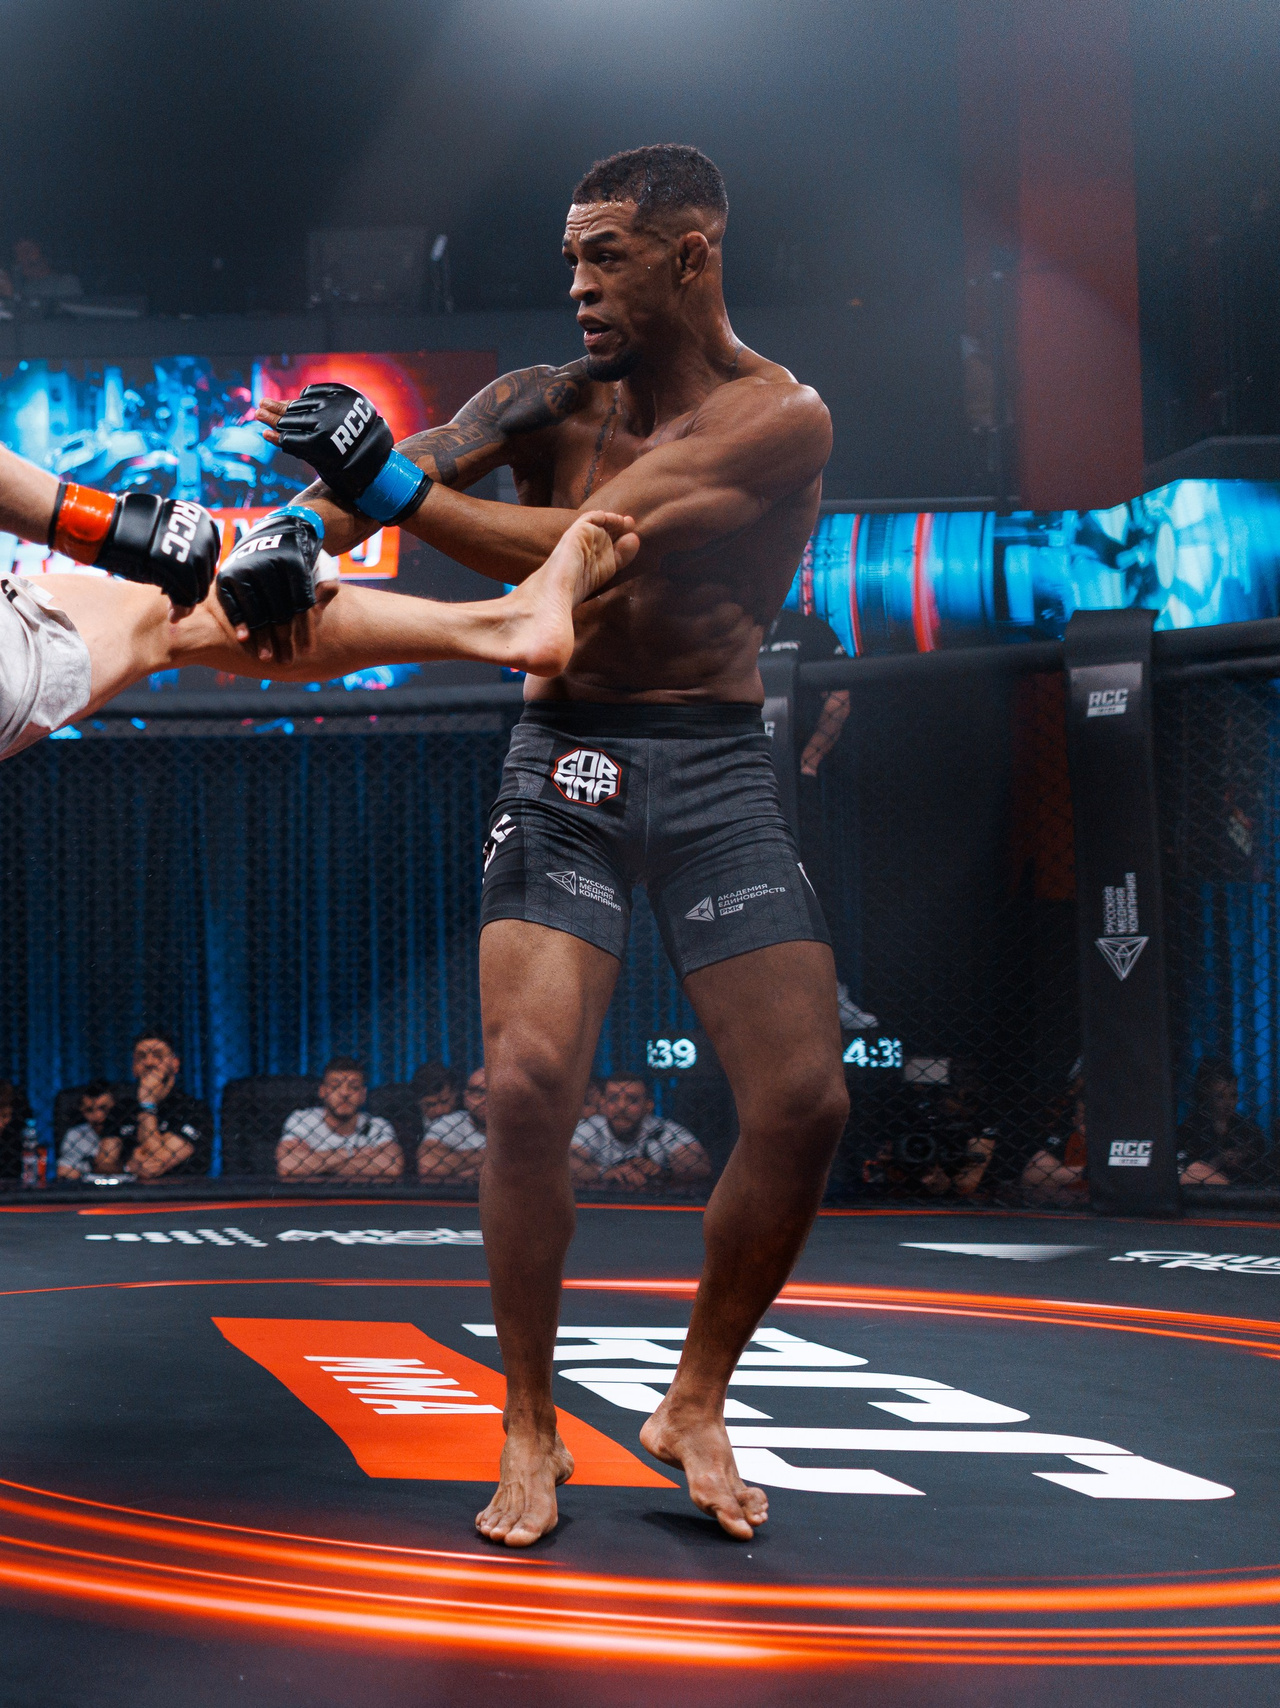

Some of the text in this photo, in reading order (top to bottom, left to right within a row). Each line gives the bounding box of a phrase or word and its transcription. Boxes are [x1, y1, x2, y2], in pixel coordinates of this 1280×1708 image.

[329, 396, 372, 456] RCC
[160, 499, 202, 563] RCC
[1088, 688, 1129, 707] RCC
[557, 749, 619, 780] GOR
[553, 772, 617, 804] MMA
[579, 876, 615, 895] РУССКАЯ
[579, 882, 614, 901] МЕДНАЯ
[717, 883, 768, 902] АКАДЕМИЯ
[718, 886, 786, 908] ЕДИНОБОРСТВ
[579, 889, 622, 912] КОМПАНИЯ
[1110, 1140, 1153, 1157] RCC
[303, 1355, 505, 1415] MMA
[462, 1324, 1235, 1500] RCC
